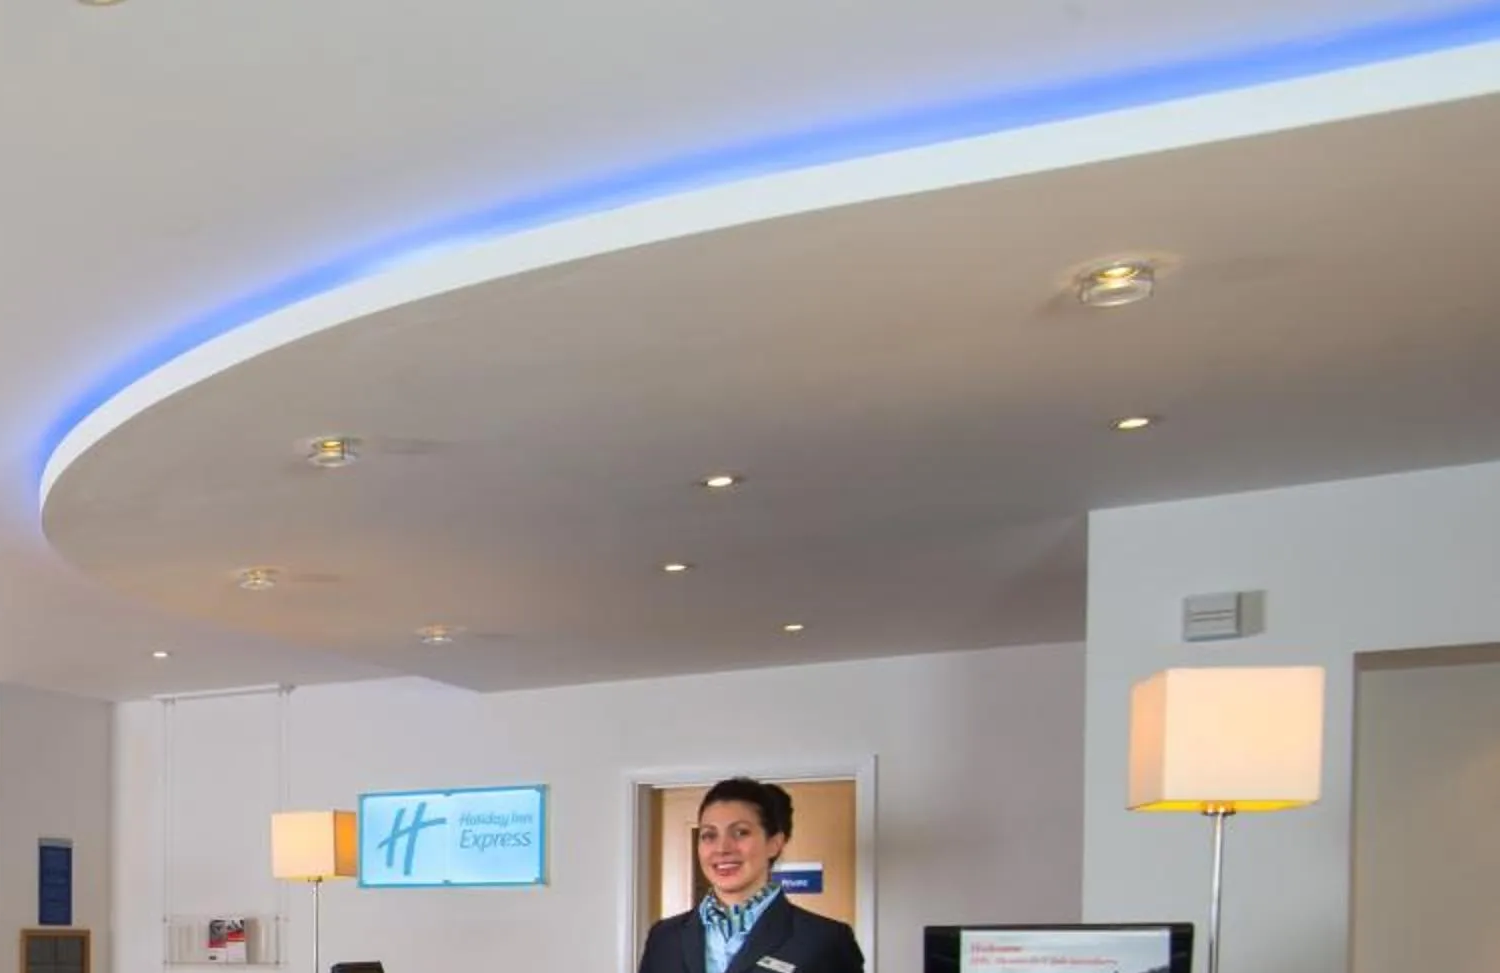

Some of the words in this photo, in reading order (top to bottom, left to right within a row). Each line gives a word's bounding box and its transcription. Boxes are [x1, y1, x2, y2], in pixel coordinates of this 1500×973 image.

[459, 811, 508, 828] Holiday
[510, 810, 533, 825] Inn
[459, 828, 533, 852] Express
